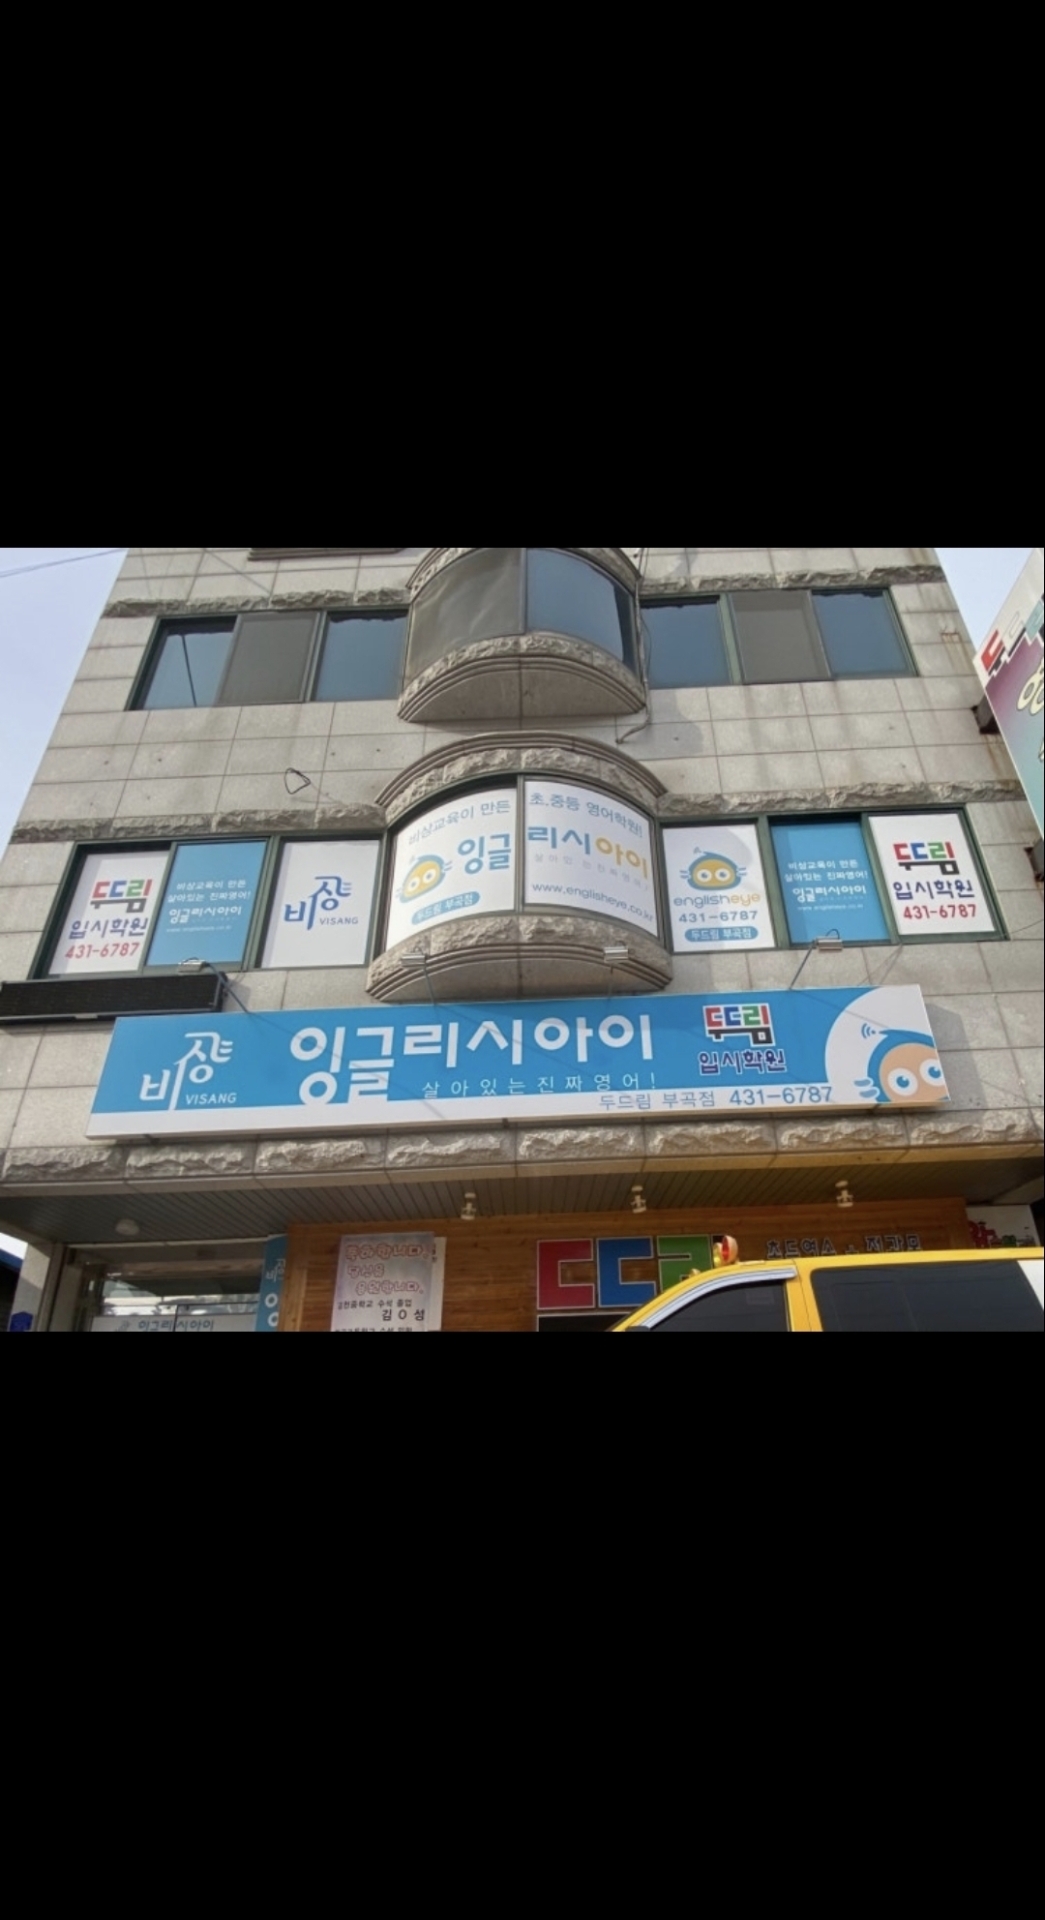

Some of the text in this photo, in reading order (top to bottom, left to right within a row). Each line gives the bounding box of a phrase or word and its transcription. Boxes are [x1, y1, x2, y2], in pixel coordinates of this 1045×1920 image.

[408, 805, 474, 845] 비상교육이
[480, 799, 511, 816] 만든
[586, 801, 643, 839] 영어학원!
[792, 885, 867, 903] 잉글리시아이
[893, 879, 975, 900] 입시학원
[284, 875, 352, 930] 비상
[532, 883, 654, 922] www.englisheye.co.kr
[674, 894, 760, 908] englisheye
[903, 903, 976, 919] 431-6787
[169, 905, 242, 924] 잉글리시아이
[319, 916, 359, 926] VISANG
[678, 911, 758, 923] 431-6787
[69, 917, 149, 939] 입시학원
[65, 942, 141, 959] 431-6787
[290, 1013, 654, 1105] 잉글리시아이
[699, 1049, 788, 1076] 입시학원
[139, 1031, 233, 1111] 비상
[185, 1092, 237, 1105] VISANG
[599, 1086, 833, 1111] 두드림 부곡점 431-6787
